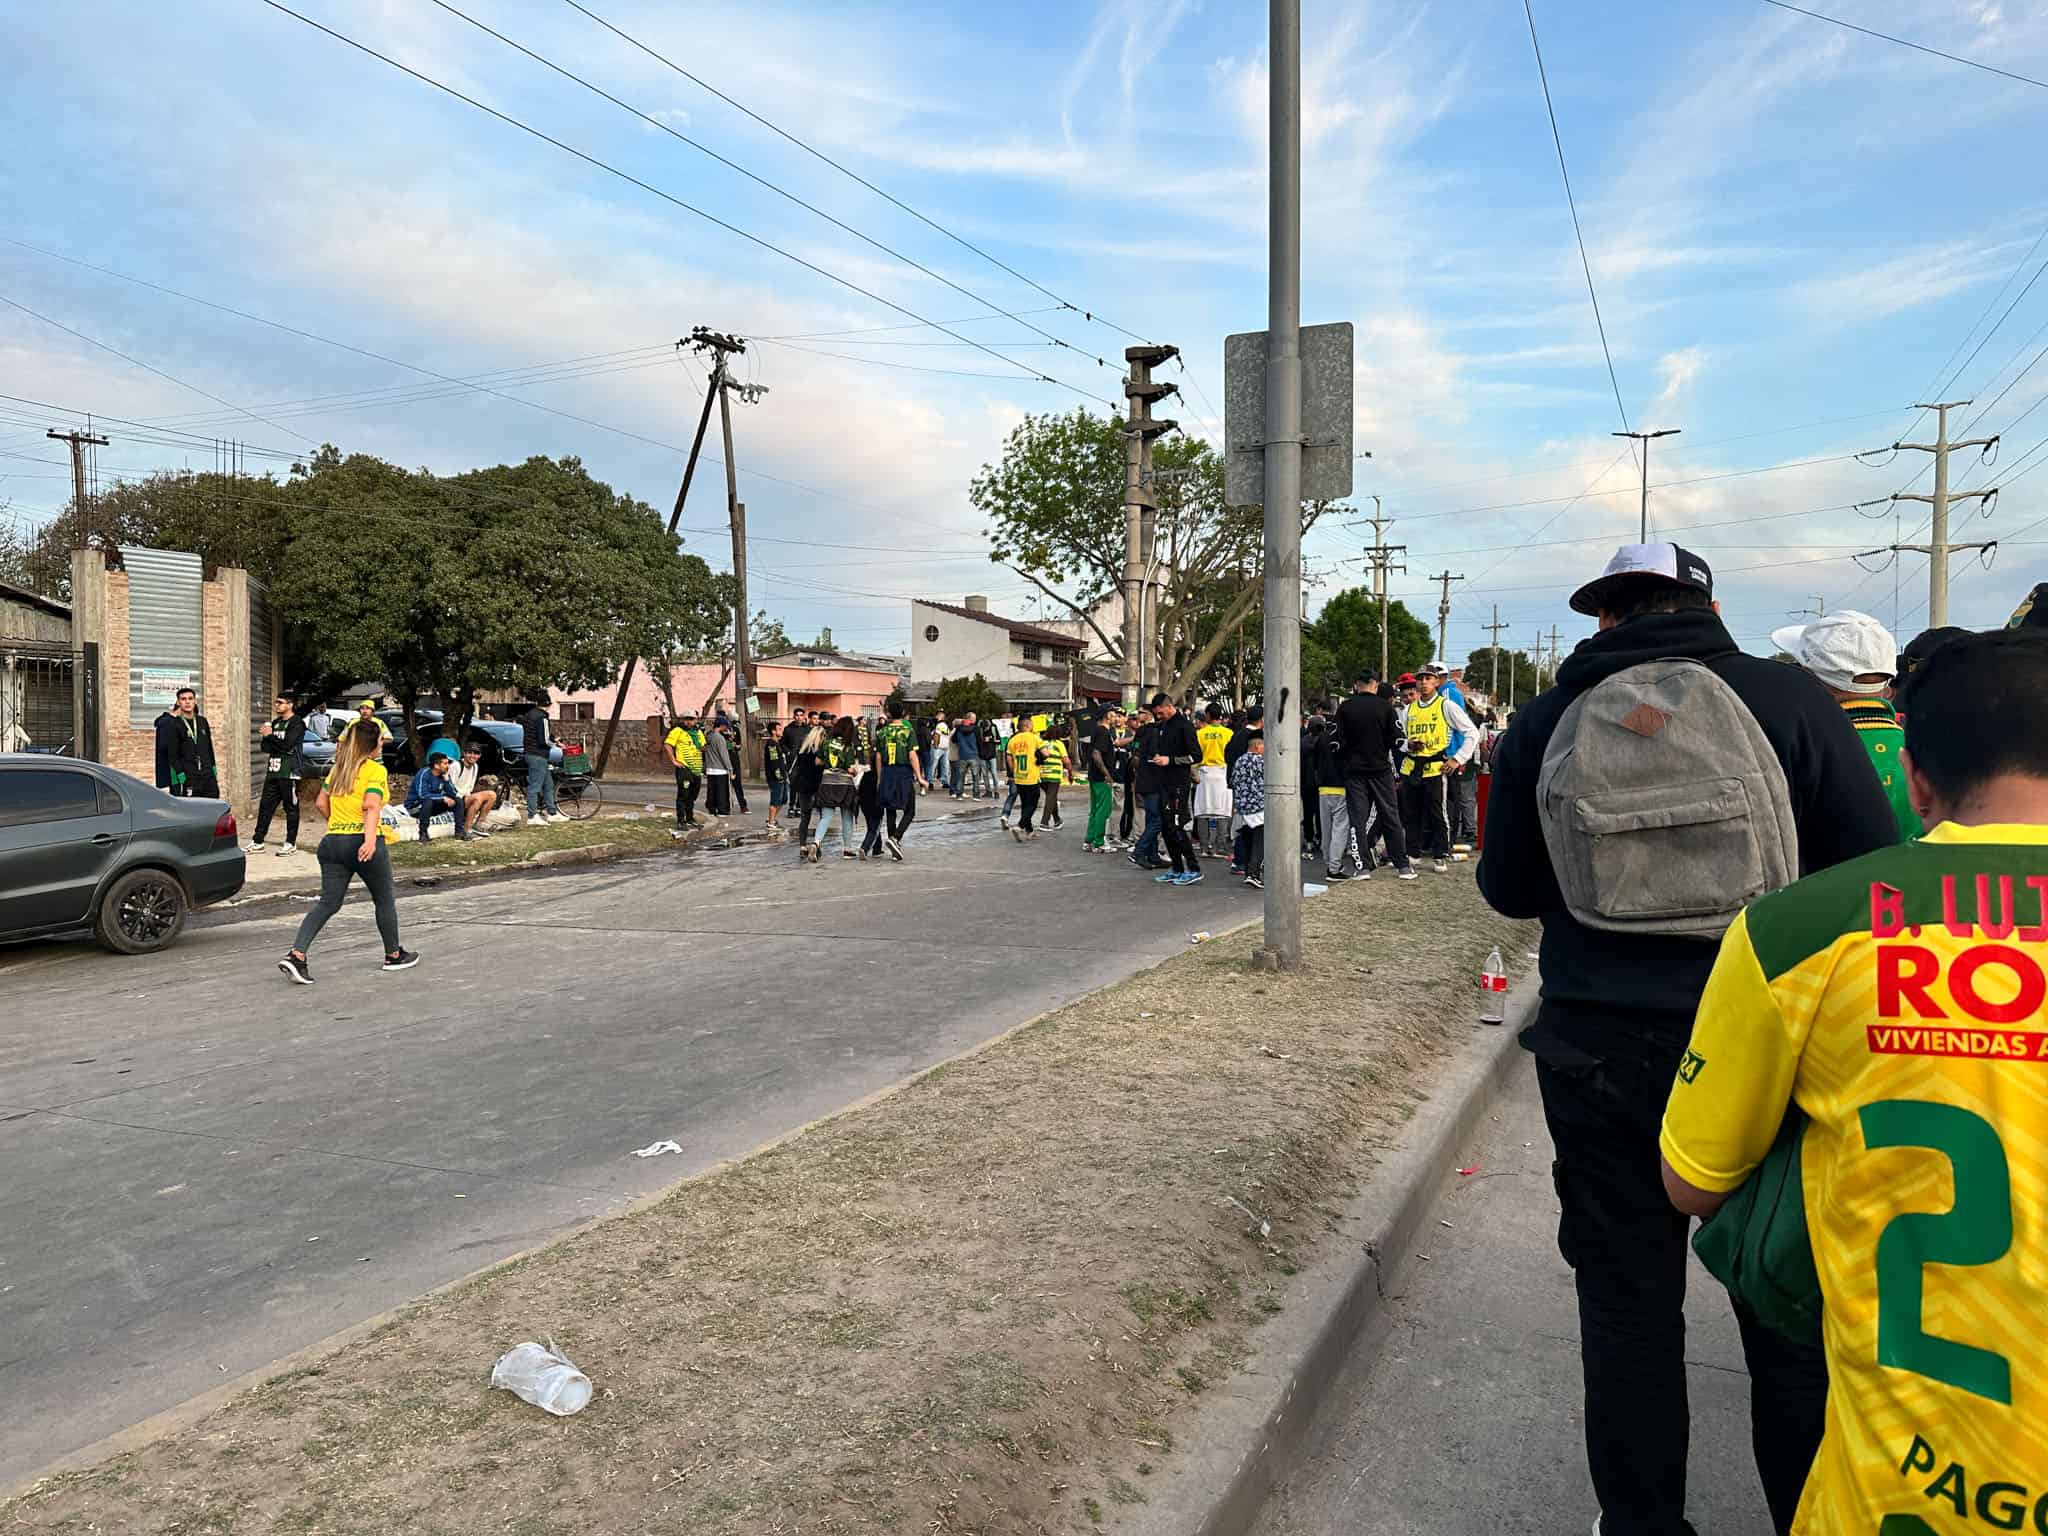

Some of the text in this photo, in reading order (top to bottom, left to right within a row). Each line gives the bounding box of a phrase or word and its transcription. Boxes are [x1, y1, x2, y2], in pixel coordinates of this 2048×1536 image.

[1350, 826, 1364, 870] adidas
[1877, 944, 2046, 1024] RO
[1873, 1029, 2027, 1056] VIVIENDAS
[1858, 1099, 2013, 1406] 2
